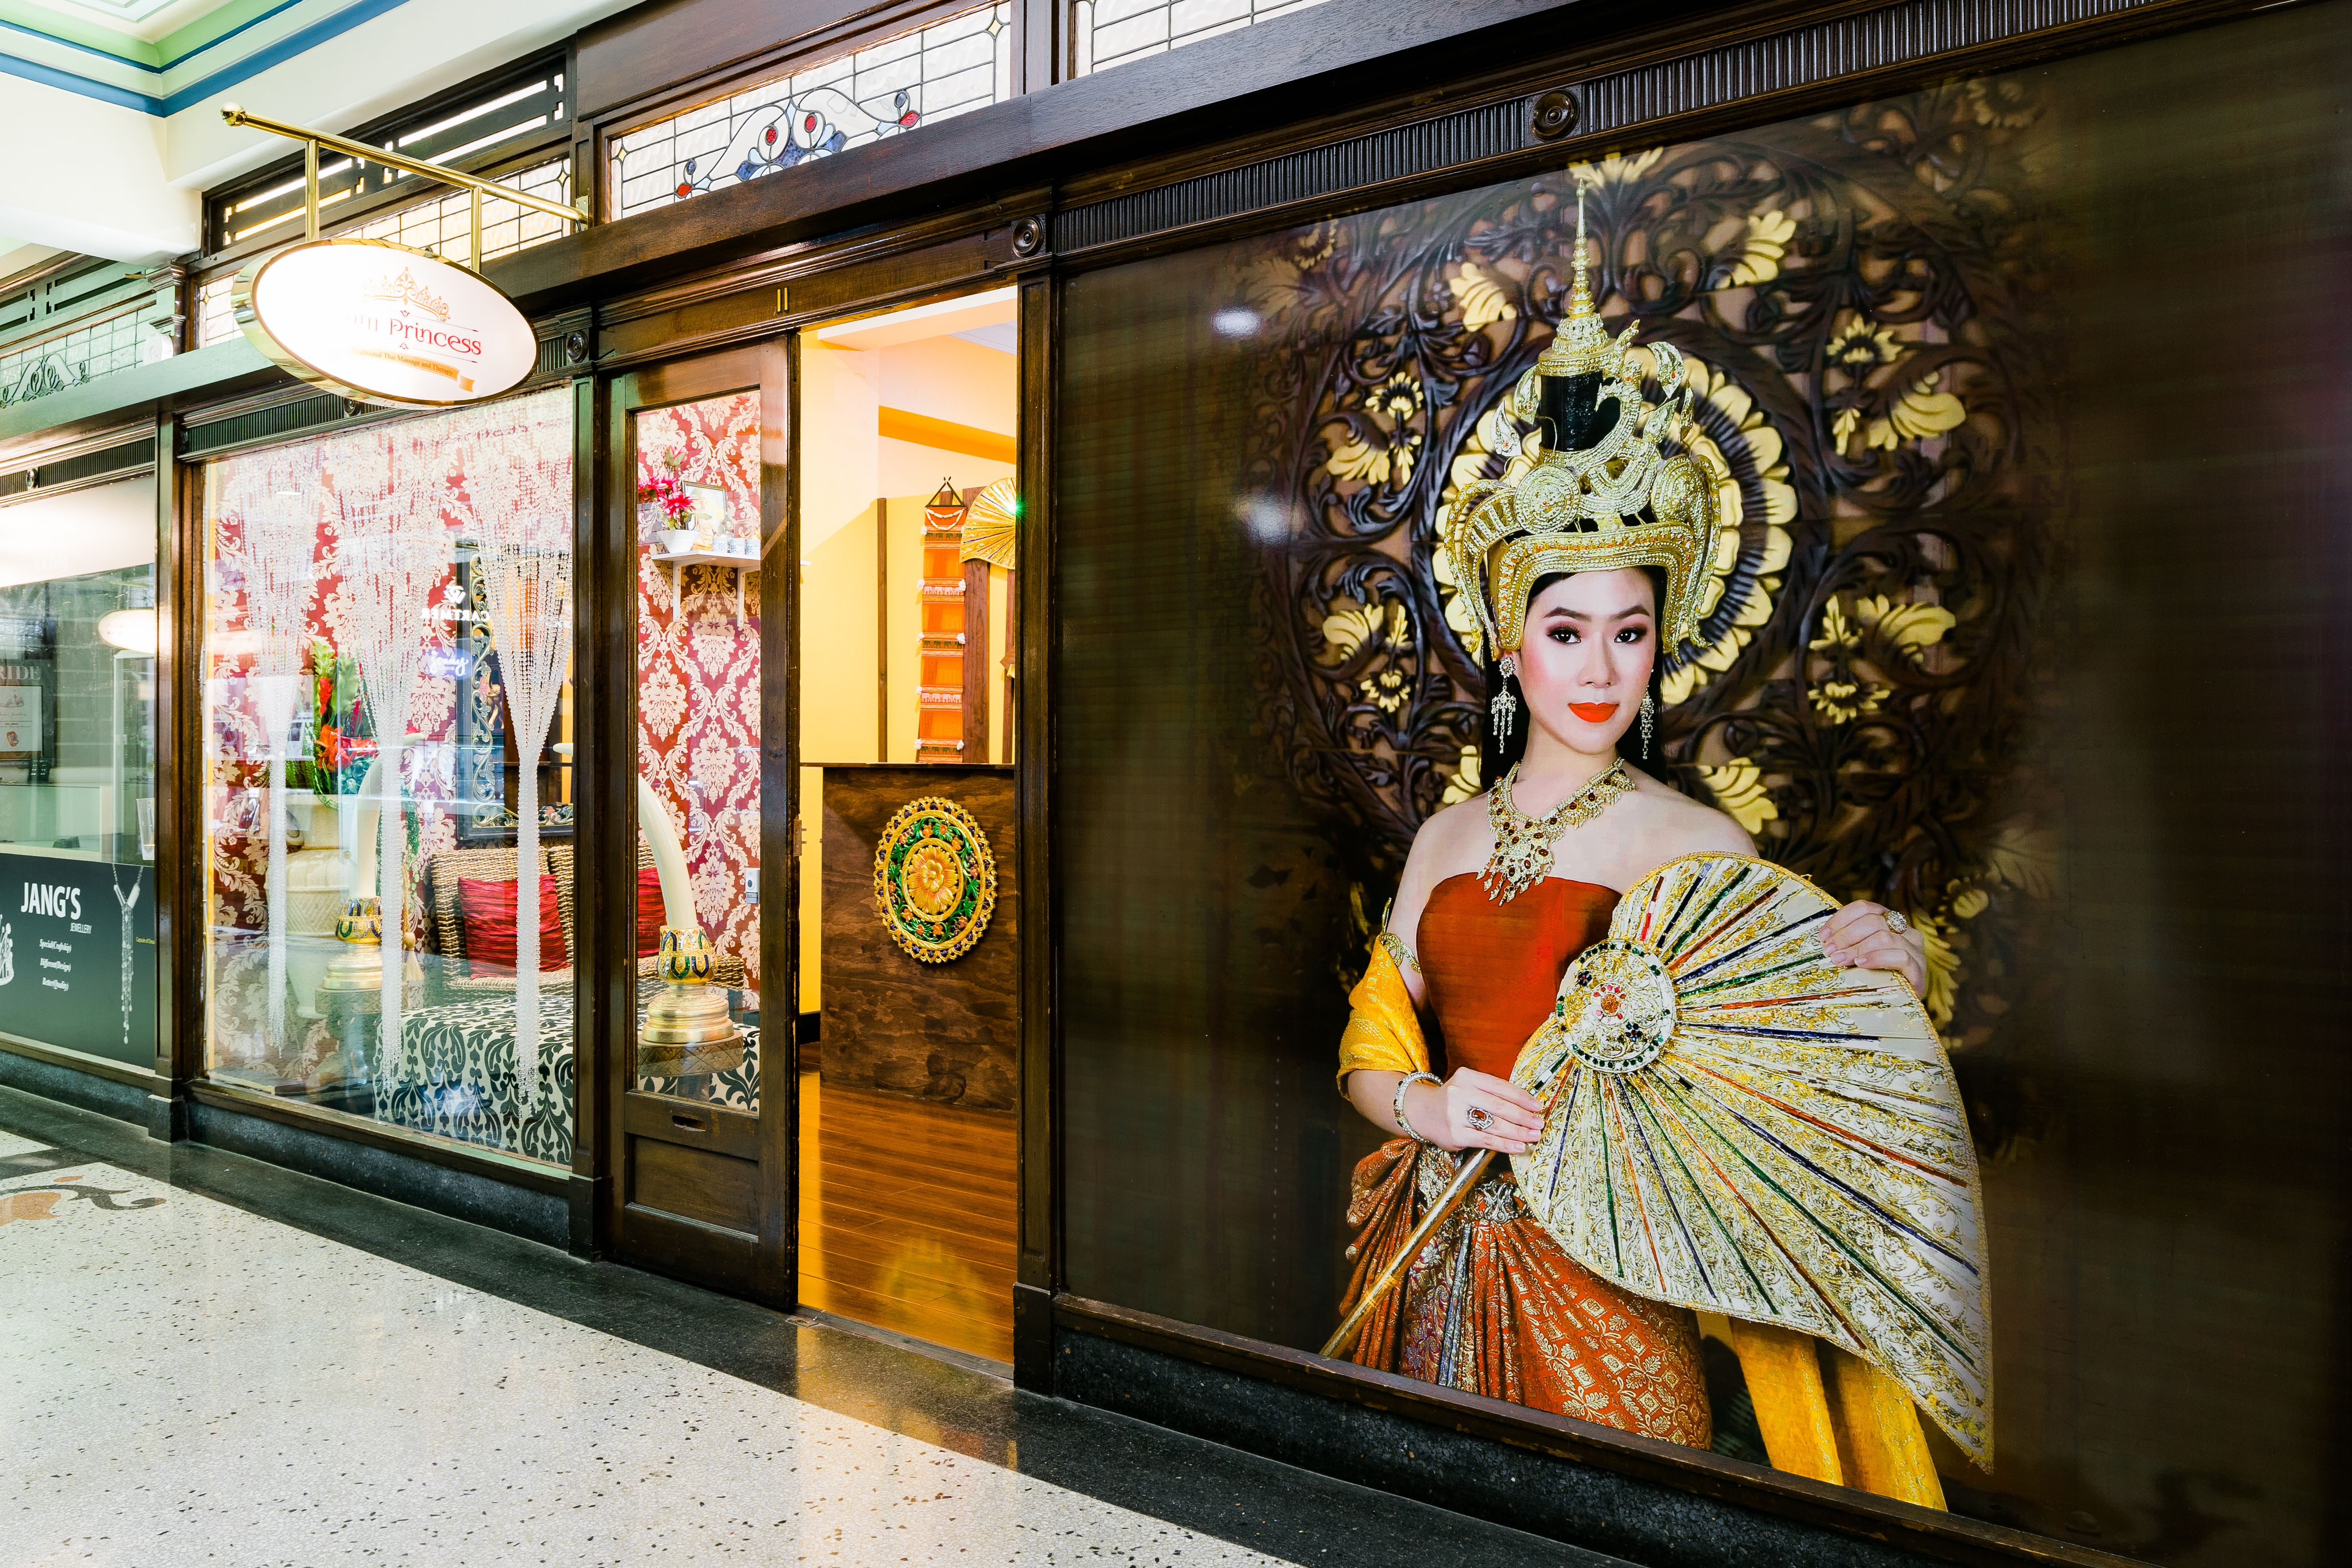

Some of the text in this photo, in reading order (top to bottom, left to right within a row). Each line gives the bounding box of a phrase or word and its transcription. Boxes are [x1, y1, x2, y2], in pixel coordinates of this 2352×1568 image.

[389, 317, 482, 355] Princess
[353, 348, 382, 358] Traditional
[383, 352, 396, 360] Thai
[397, 355, 420, 366] Massage
[432, 363, 453, 376] Therapy
[21, 882, 81, 920] JANG'S
[70, 922, 92, 934] JEWELLERY
